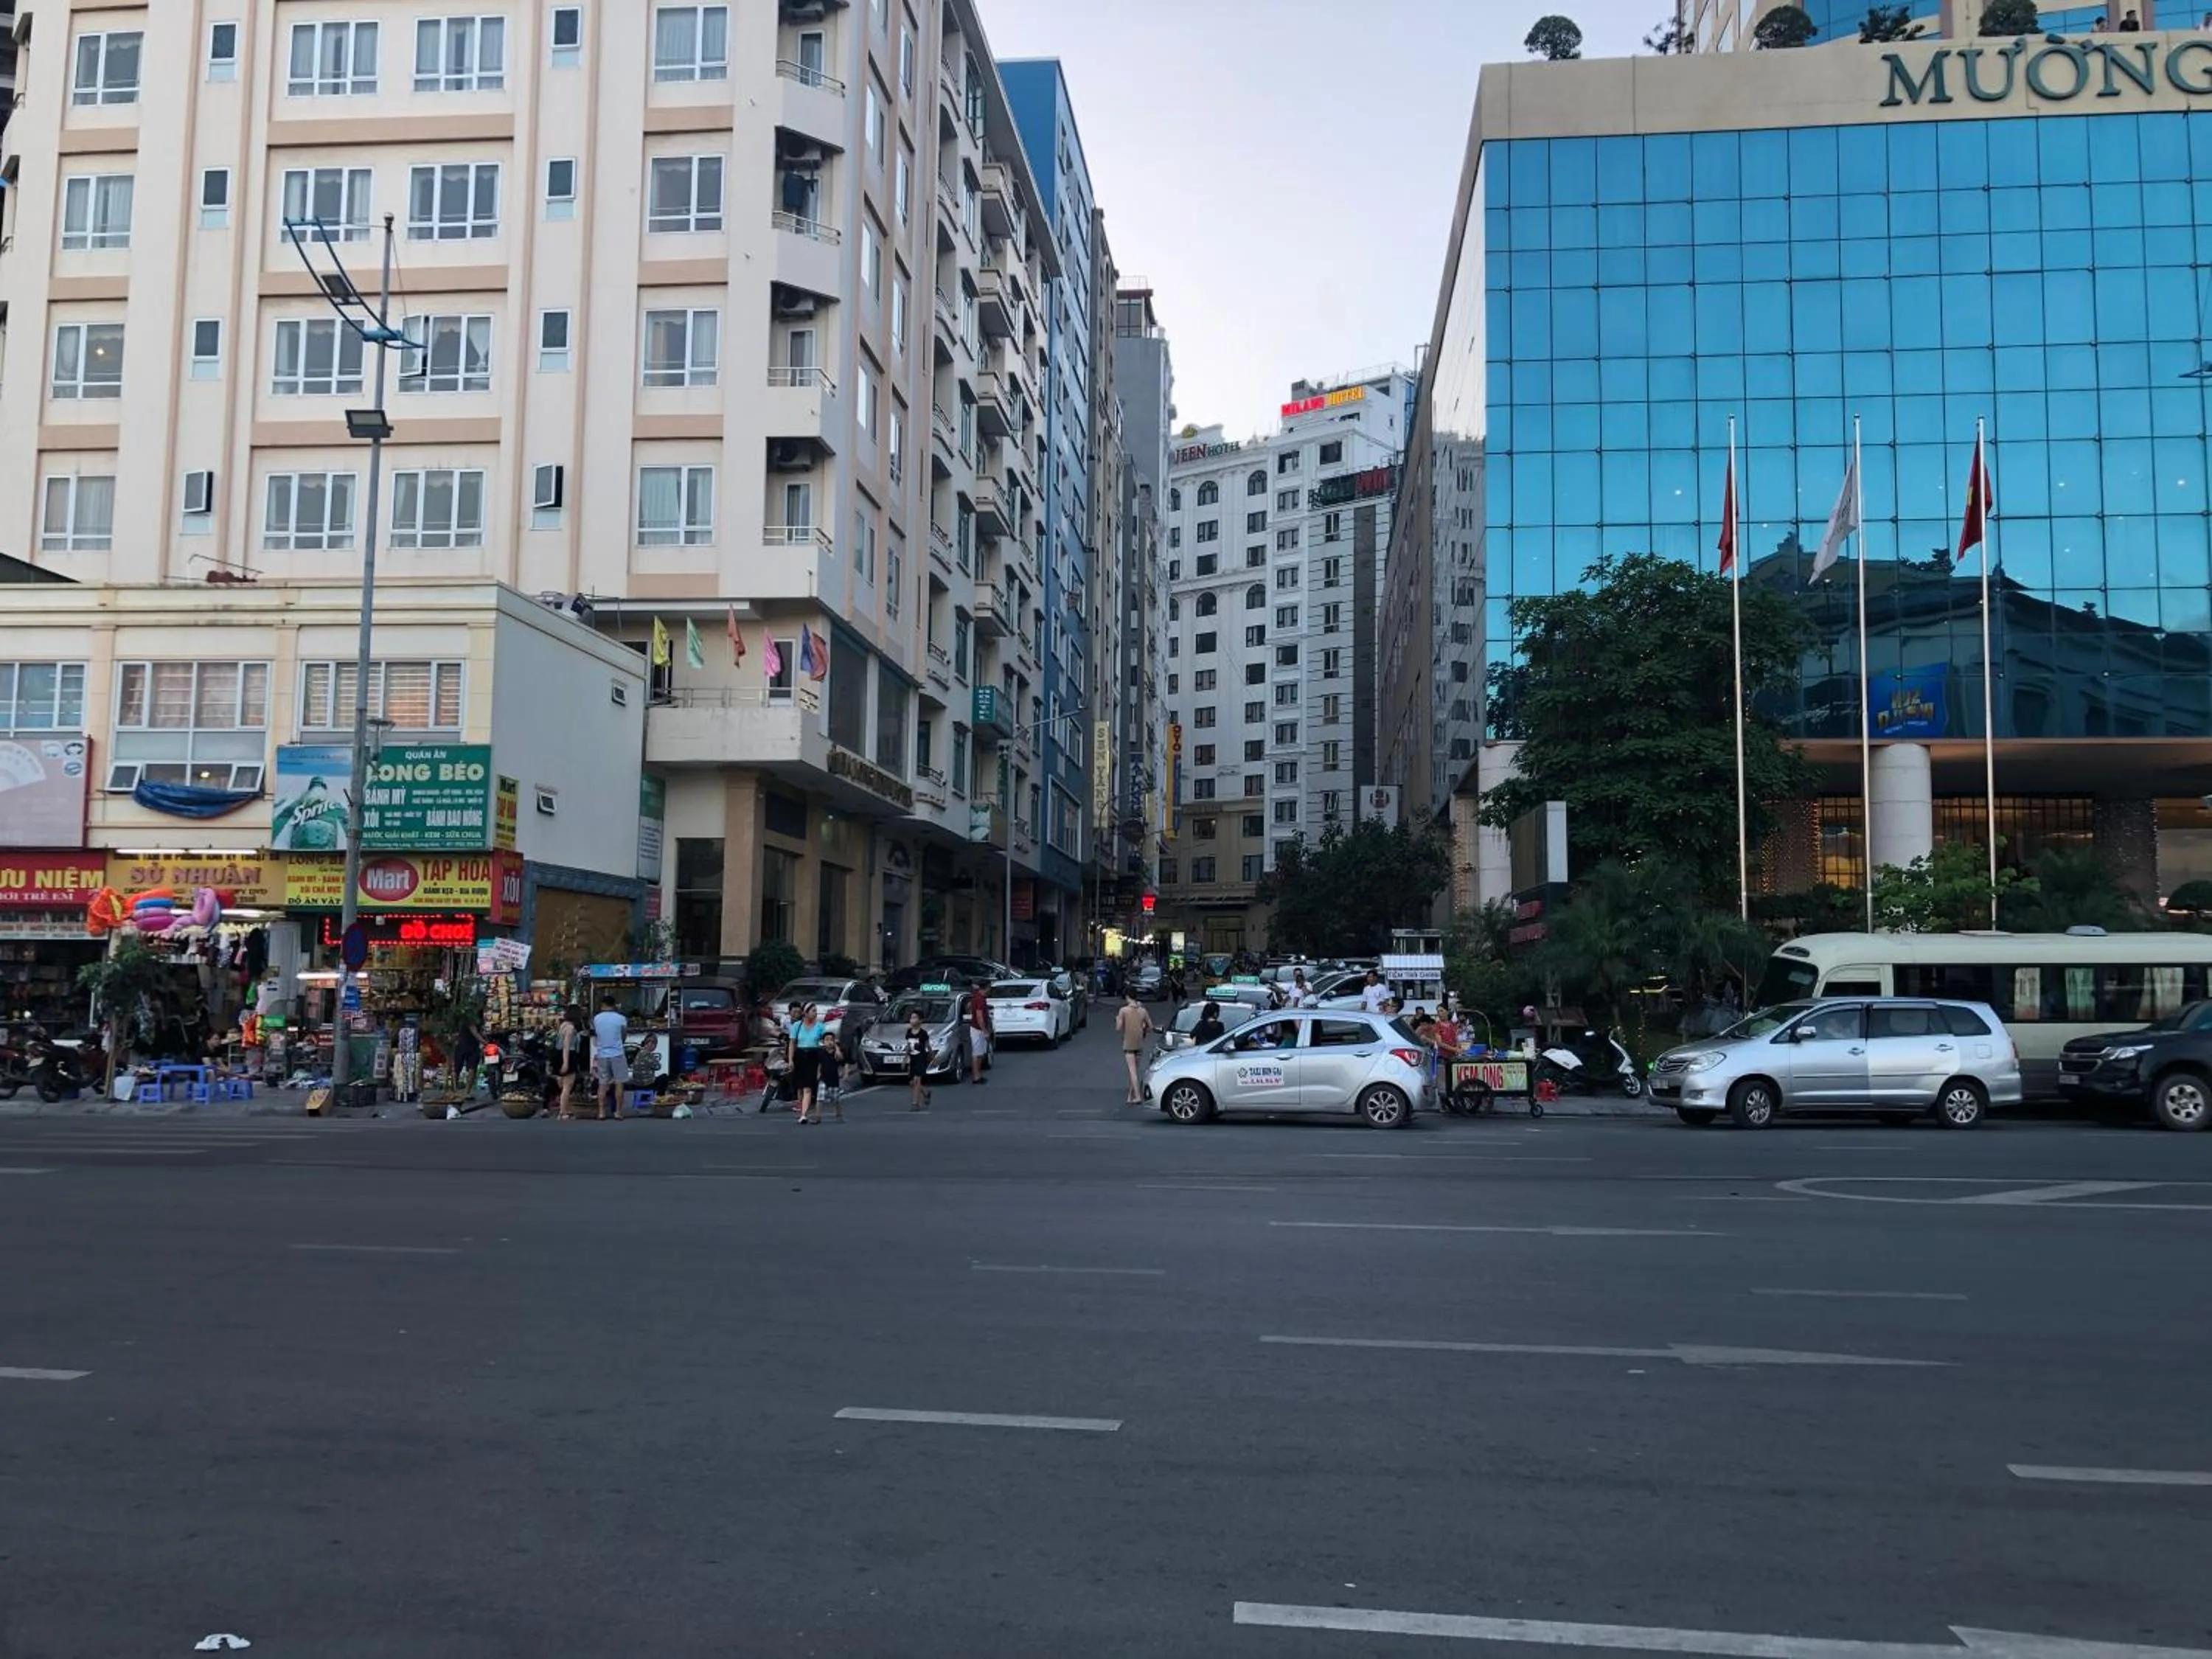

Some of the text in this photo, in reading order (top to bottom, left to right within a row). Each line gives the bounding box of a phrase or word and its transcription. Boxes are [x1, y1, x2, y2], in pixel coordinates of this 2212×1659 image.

[439, 760, 484, 782] BÉO
[291, 799, 344, 827] Sprite
[367, 868, 411, 890] Mart
